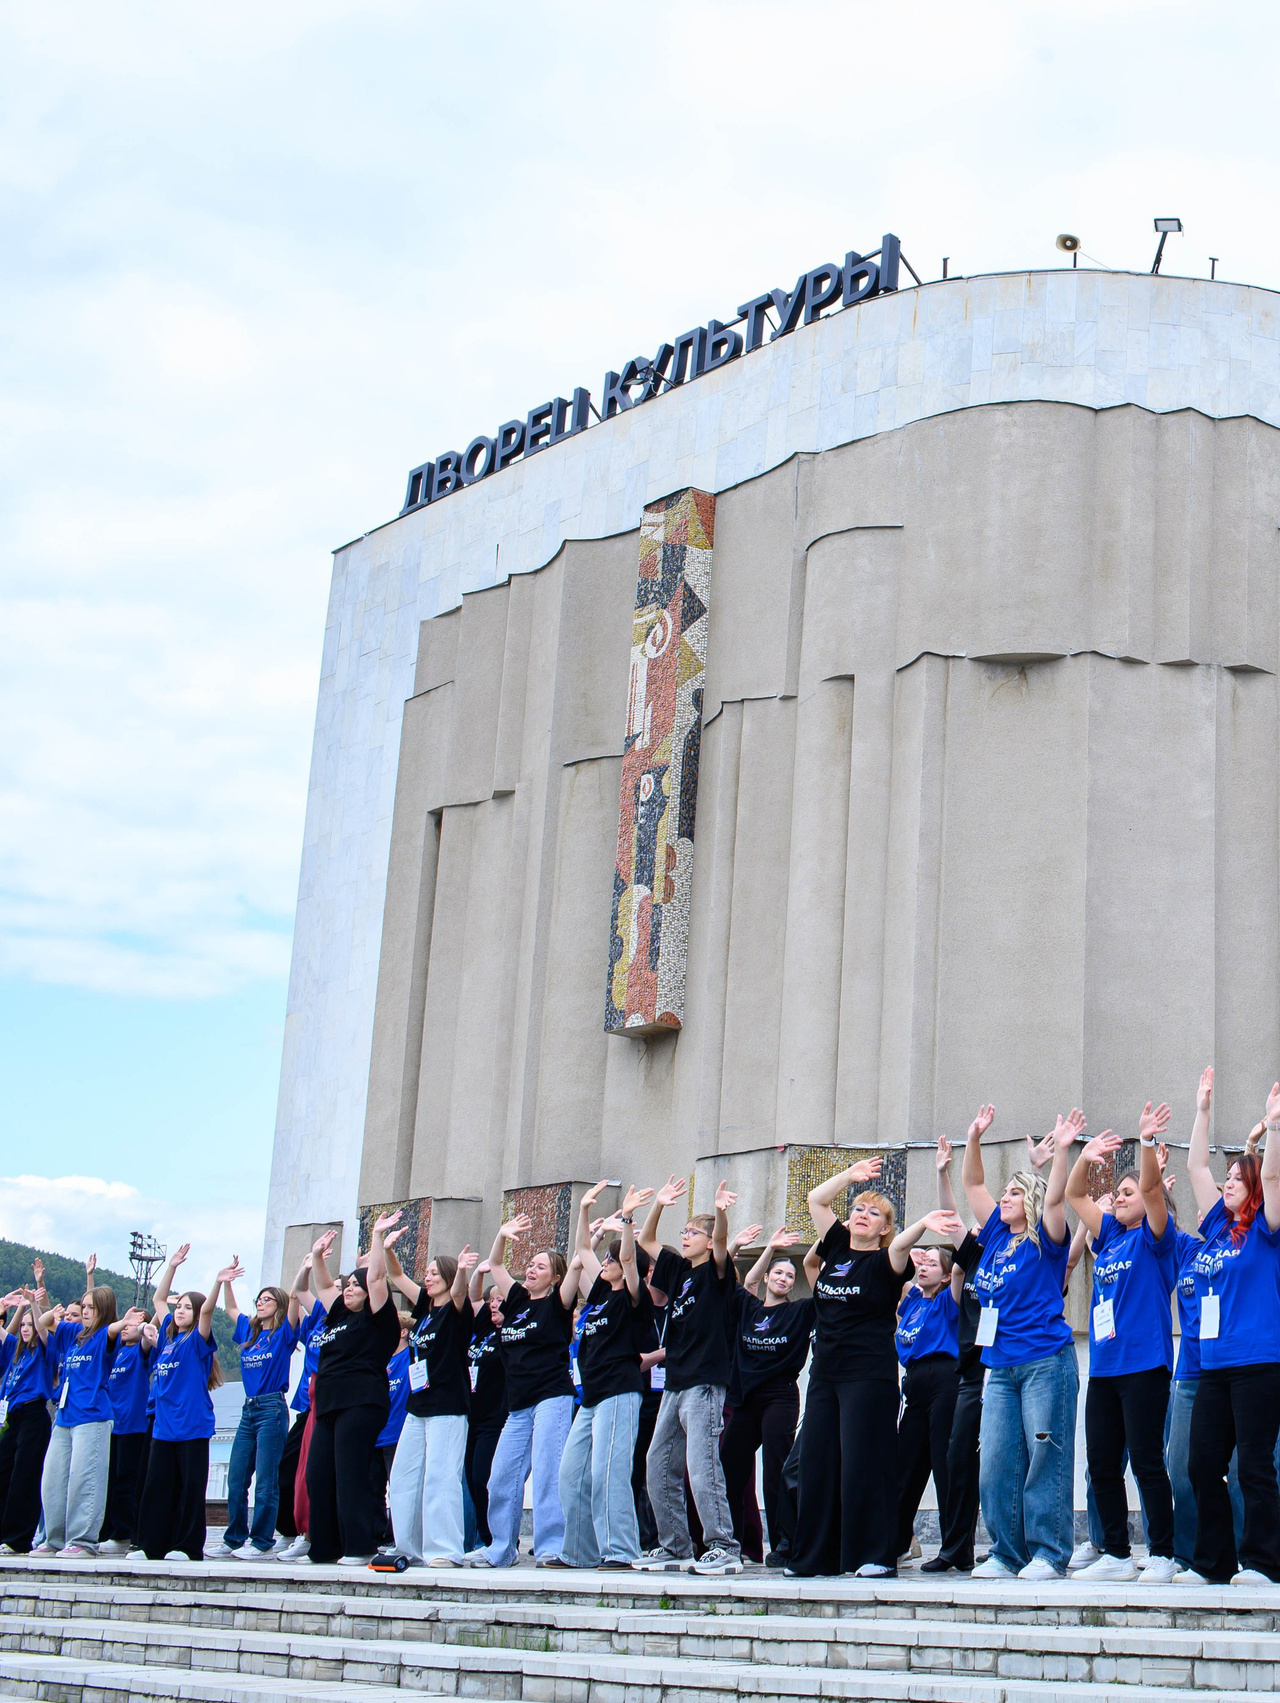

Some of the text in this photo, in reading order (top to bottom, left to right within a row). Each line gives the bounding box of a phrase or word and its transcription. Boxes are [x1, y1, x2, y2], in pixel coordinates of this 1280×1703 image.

[400, 233, 900, 516] ДВОРЕЦ КУЛЬТУРЫ
[817, 1281, 861, 1295] РАЛЬСКАЯ
[742, 1336, 787, 1345] РАЛЬСКАЯ
[241, 1352, 273, 1362] АЛЬСКАЯ
